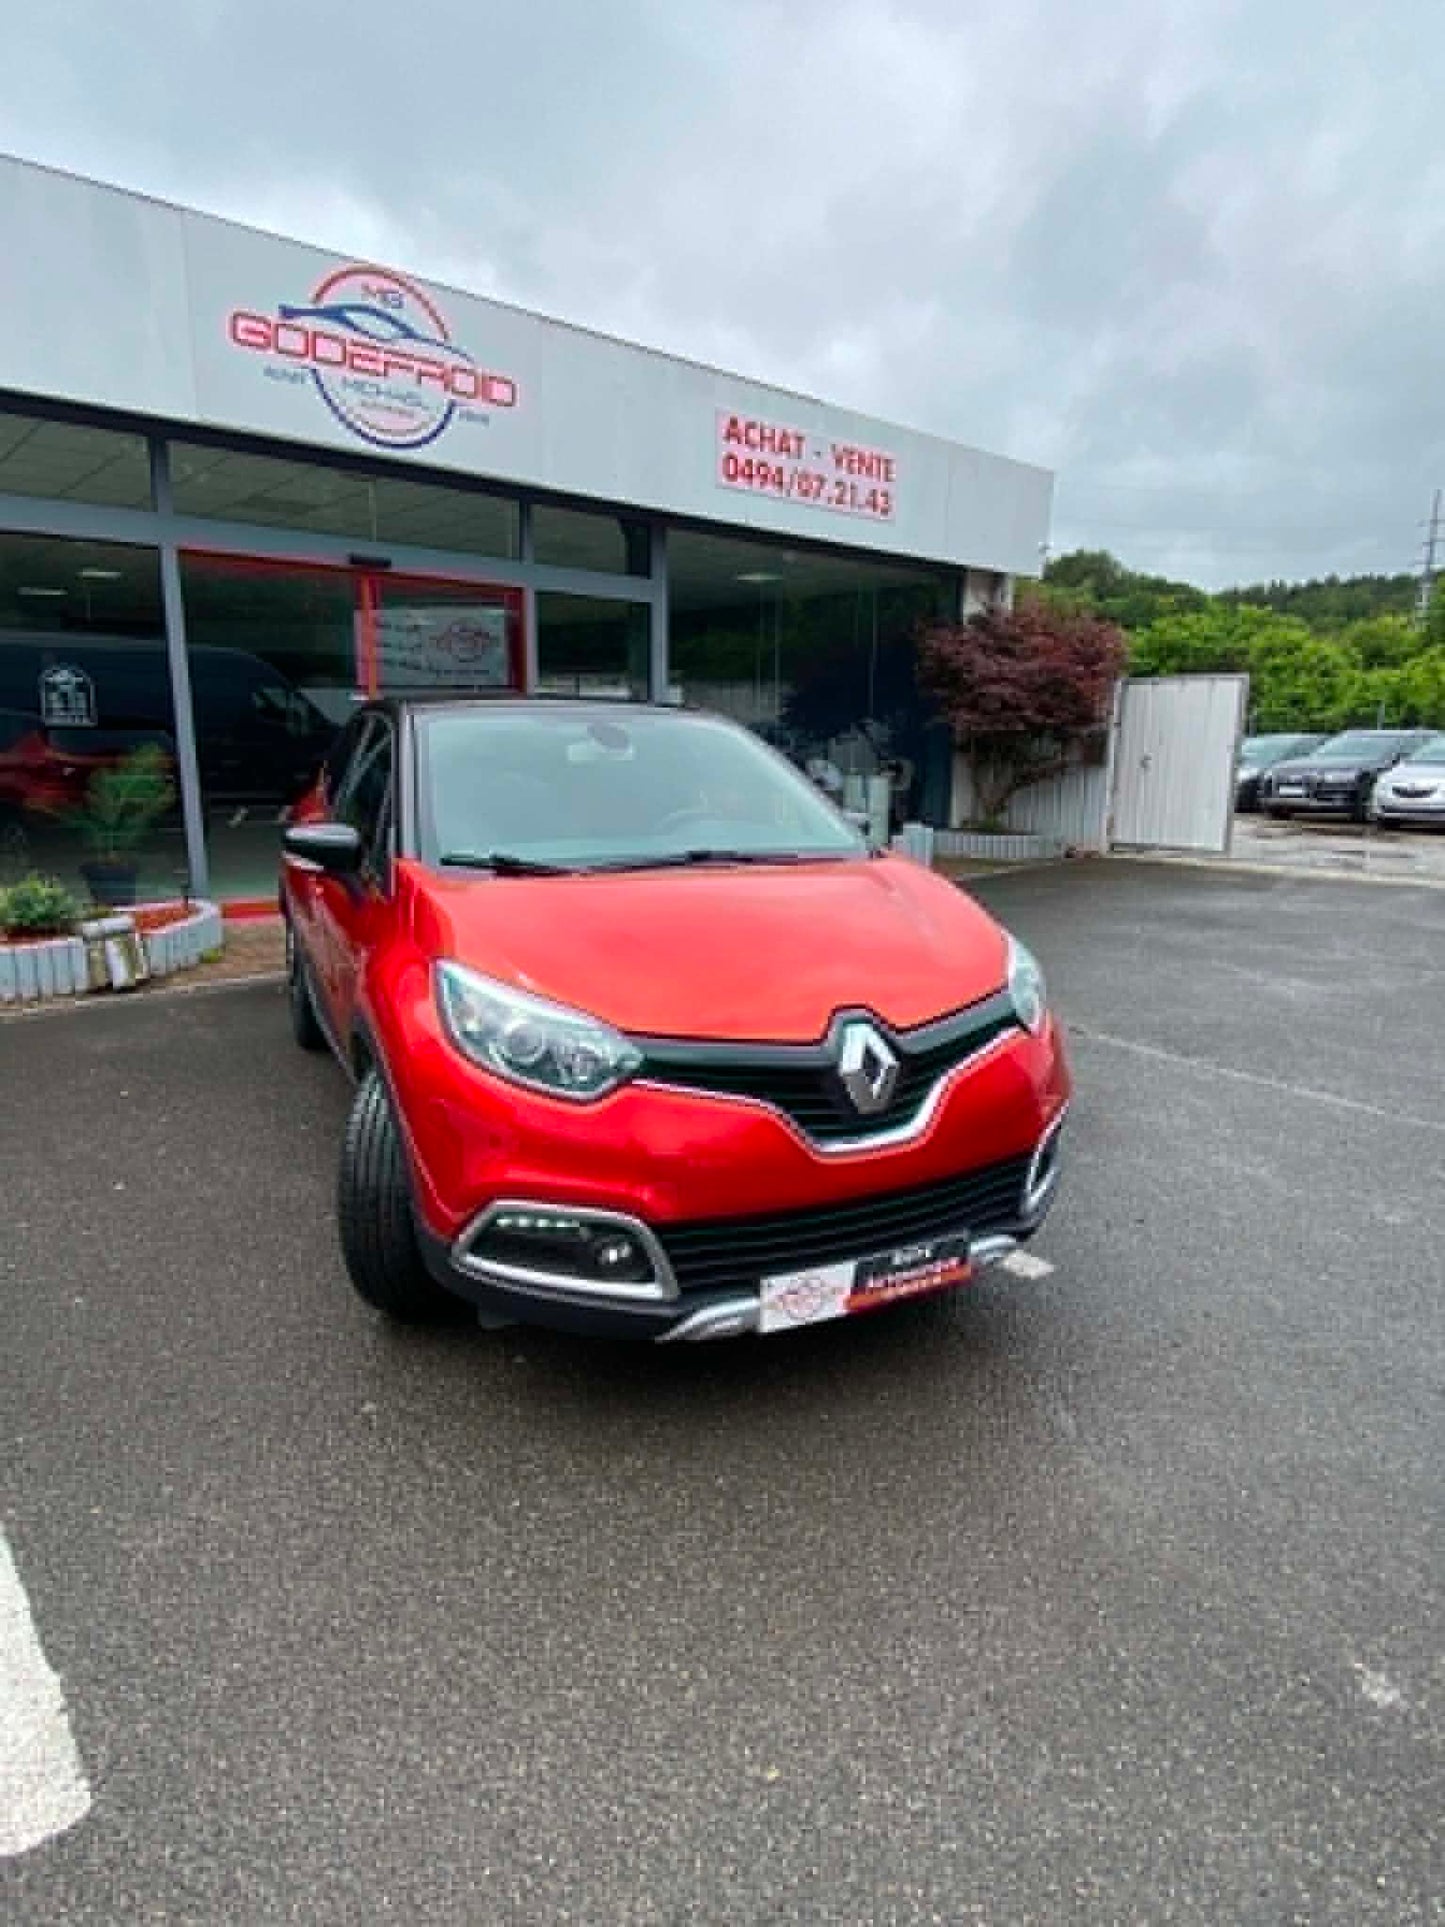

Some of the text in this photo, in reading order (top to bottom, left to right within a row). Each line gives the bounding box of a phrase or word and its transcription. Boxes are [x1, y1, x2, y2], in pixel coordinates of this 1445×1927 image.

[229, 311, 517, 408] GODEFROID
[724, 416, 805, 459] ACHAT
[830, 443, 896, 482] VENTE
[722, 453, 892, 516] 0494/07.21.43
